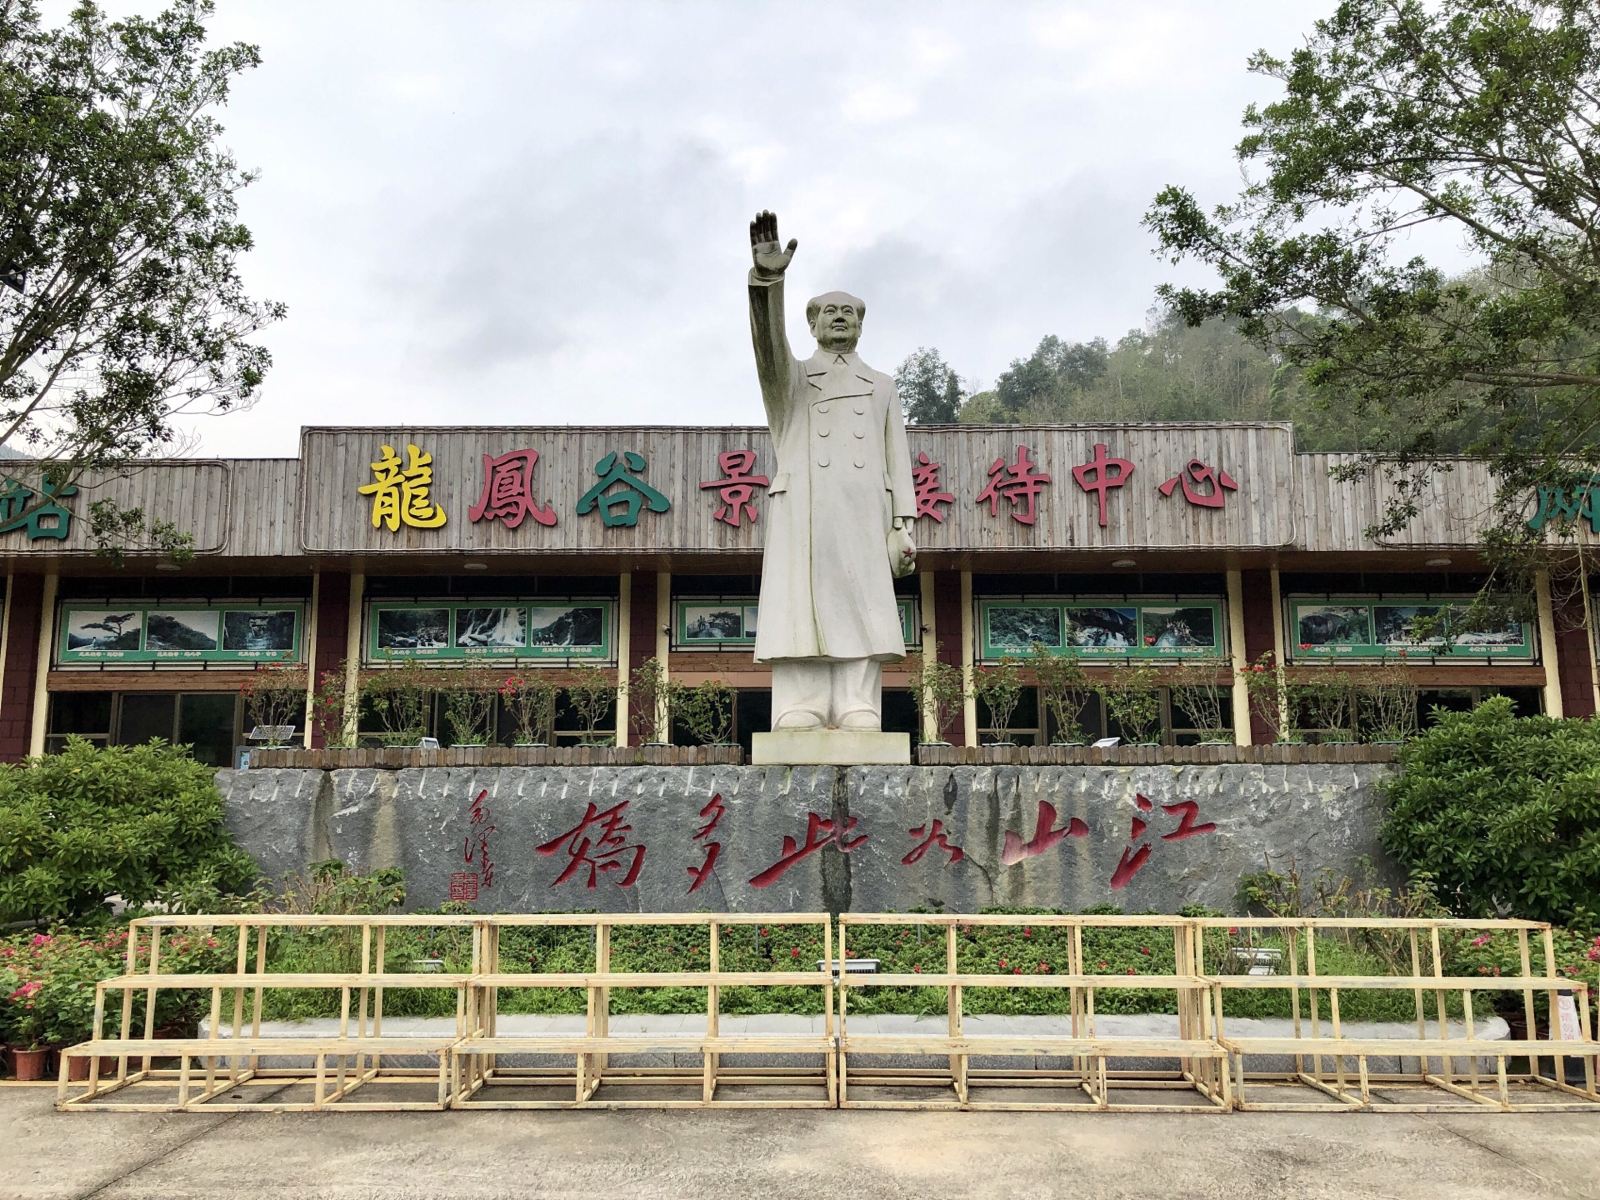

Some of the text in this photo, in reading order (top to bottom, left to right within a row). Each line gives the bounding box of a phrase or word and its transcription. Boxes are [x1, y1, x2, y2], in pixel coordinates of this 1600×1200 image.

[358, 443, 1239, 532] 龍鳳谷景接待中心
